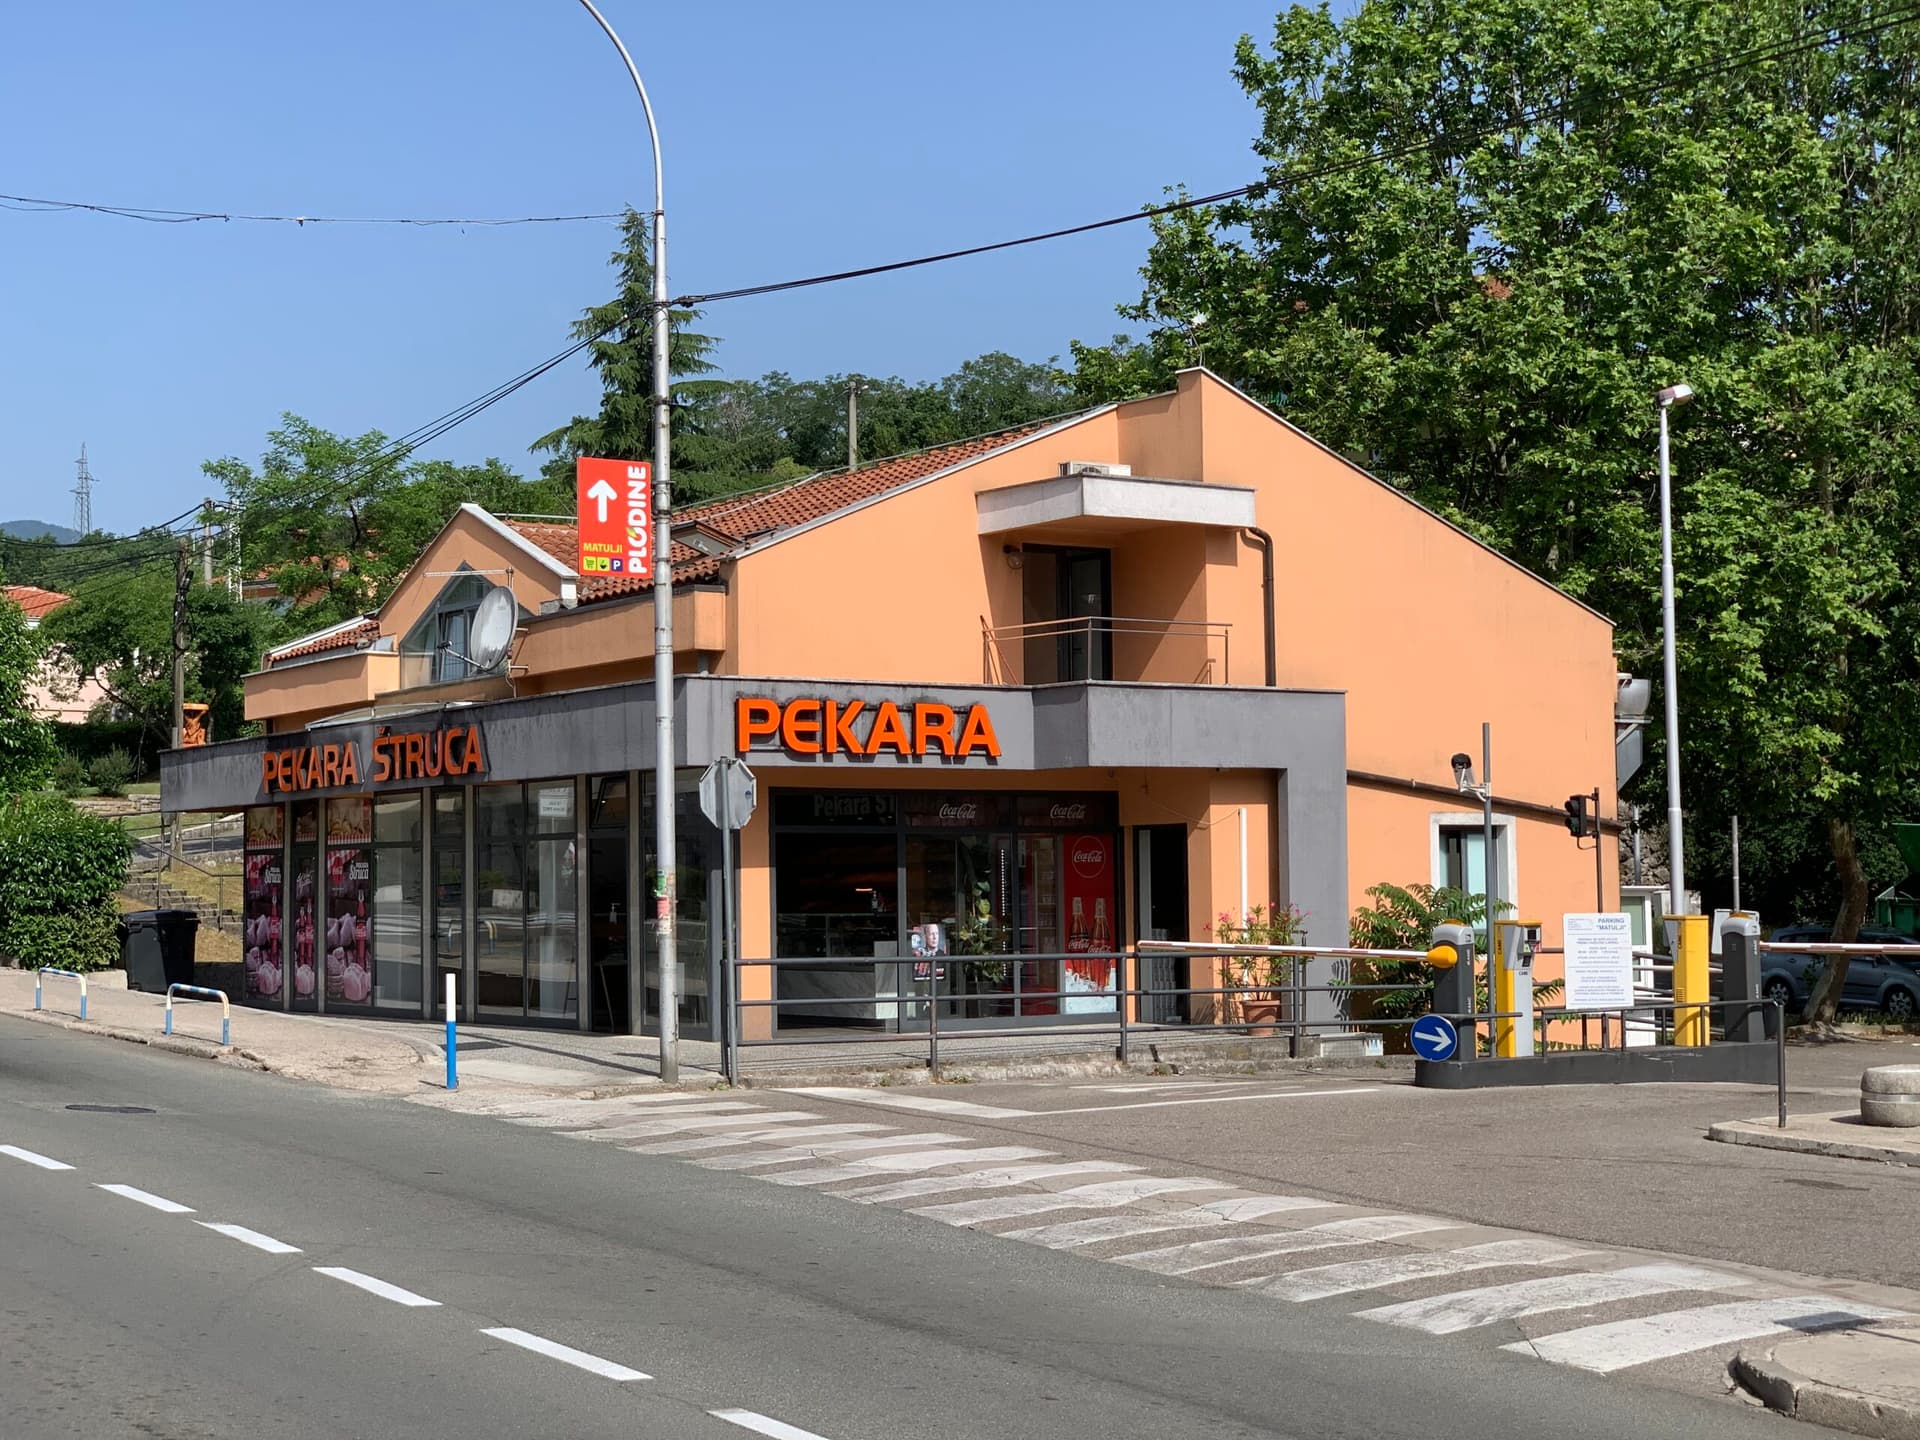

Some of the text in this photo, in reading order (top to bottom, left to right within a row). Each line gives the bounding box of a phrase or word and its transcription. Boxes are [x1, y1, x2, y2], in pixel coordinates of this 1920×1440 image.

[627, 466, 648, 574] PLODINE
[583, 543, 623, 554] MATULJI
[613, 559, 622, 571] P
[736, 698, 1002, 758] PEKARA
[263, 726, 484, 794] PEKARA ŠTRUCA
[1598, 917, 1625, 925] PARKING
